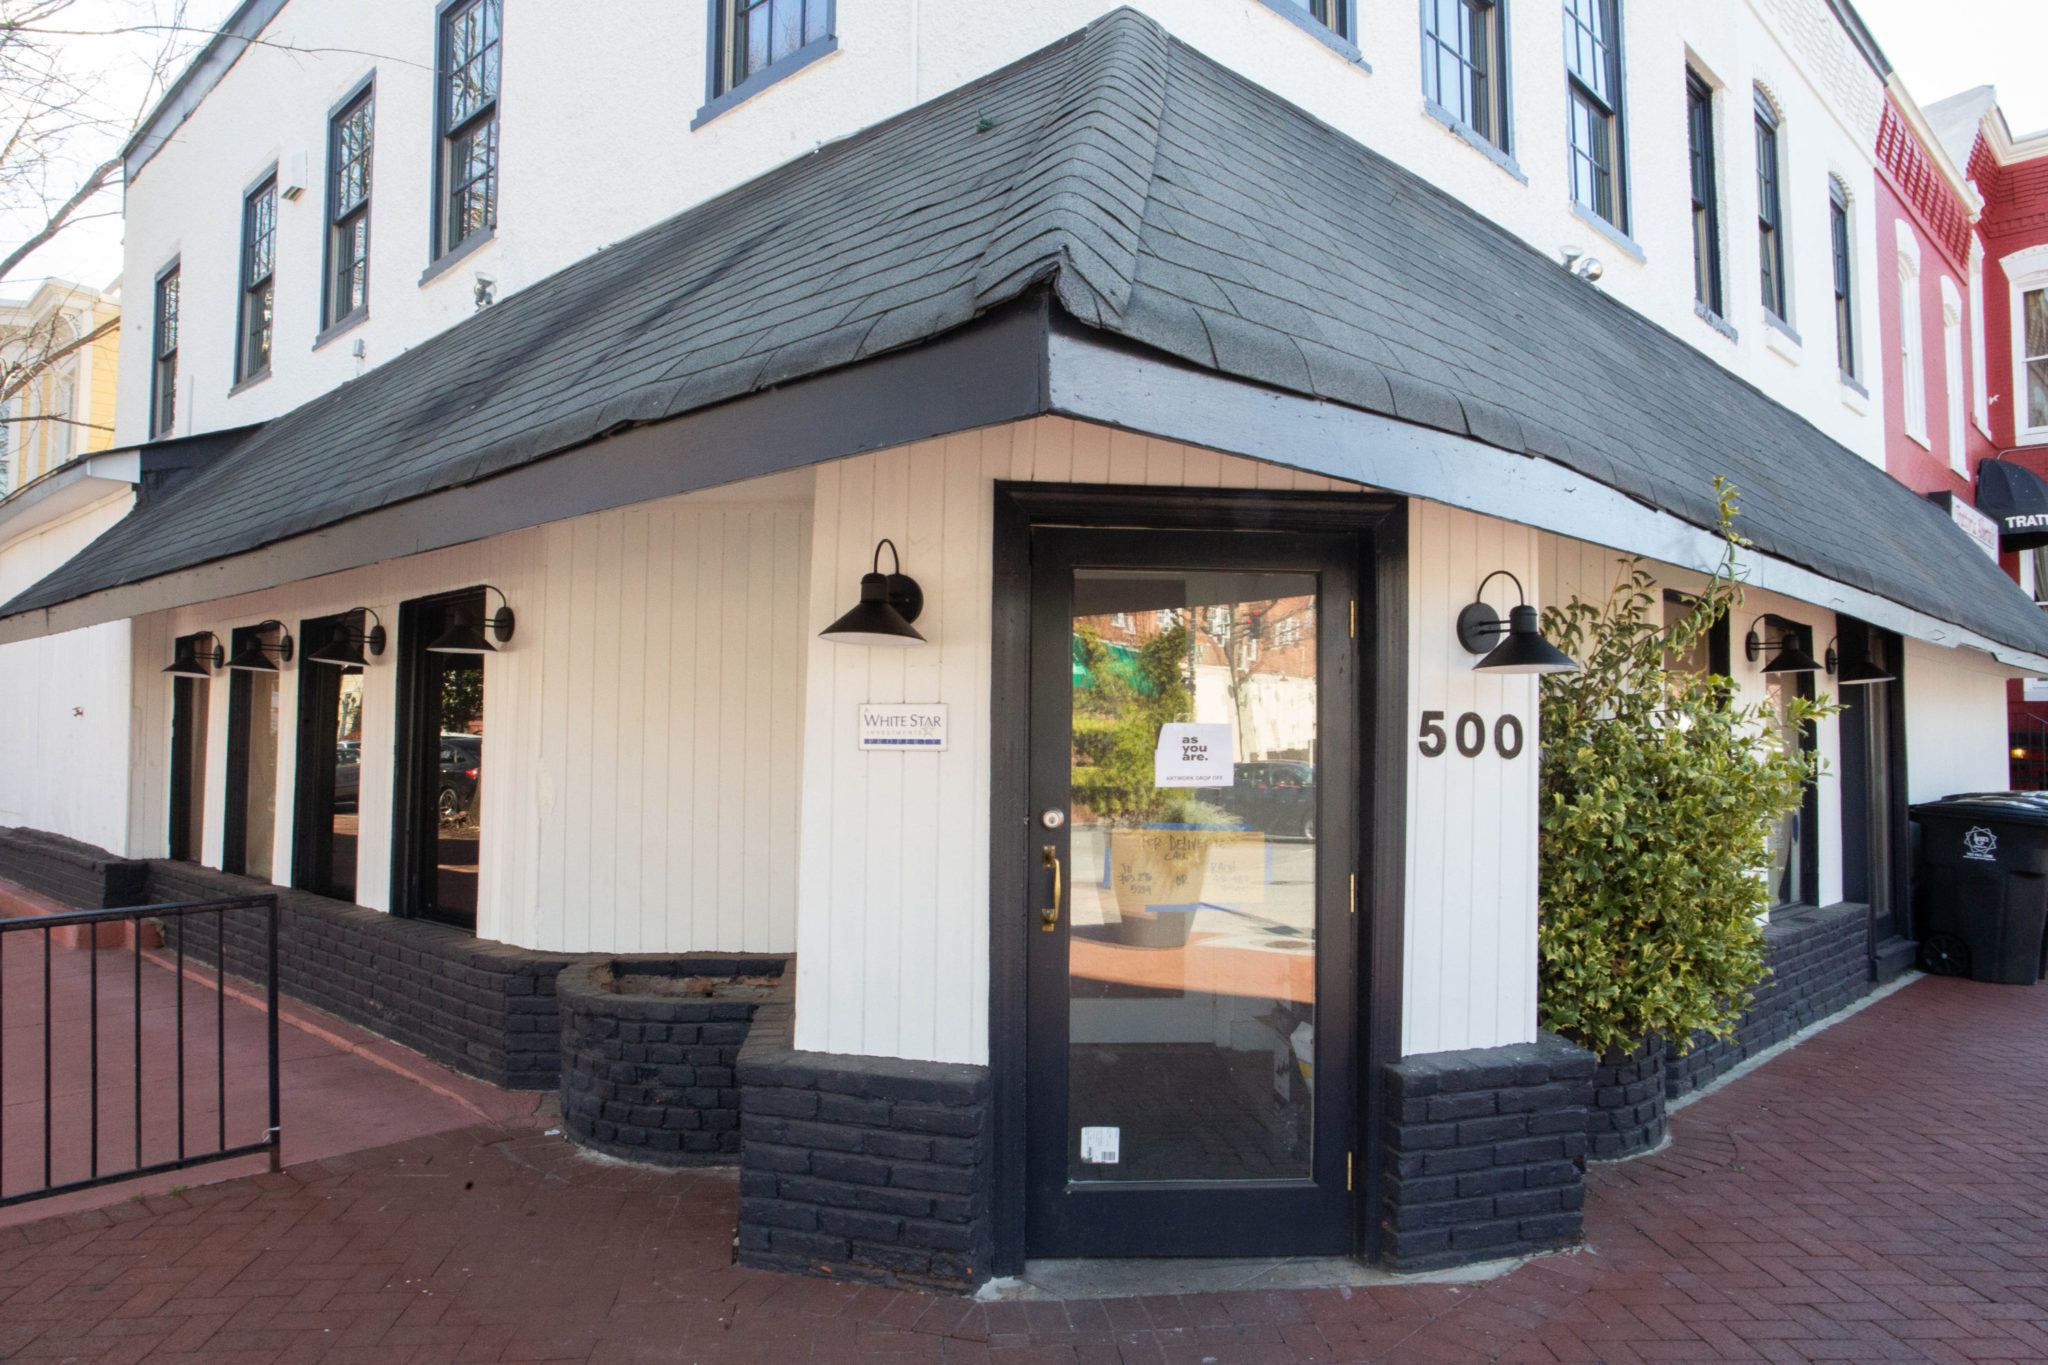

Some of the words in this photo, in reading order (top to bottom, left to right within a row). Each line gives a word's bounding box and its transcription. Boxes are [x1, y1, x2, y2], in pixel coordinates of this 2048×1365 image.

[864, 714, 907, 727] WHITE
[910, 714, 941, 727] STAR
[1182, 736, 1198, 744] as
[1418, 710, 1524, 760] 500
[1182, 745, 1207, 756] you
